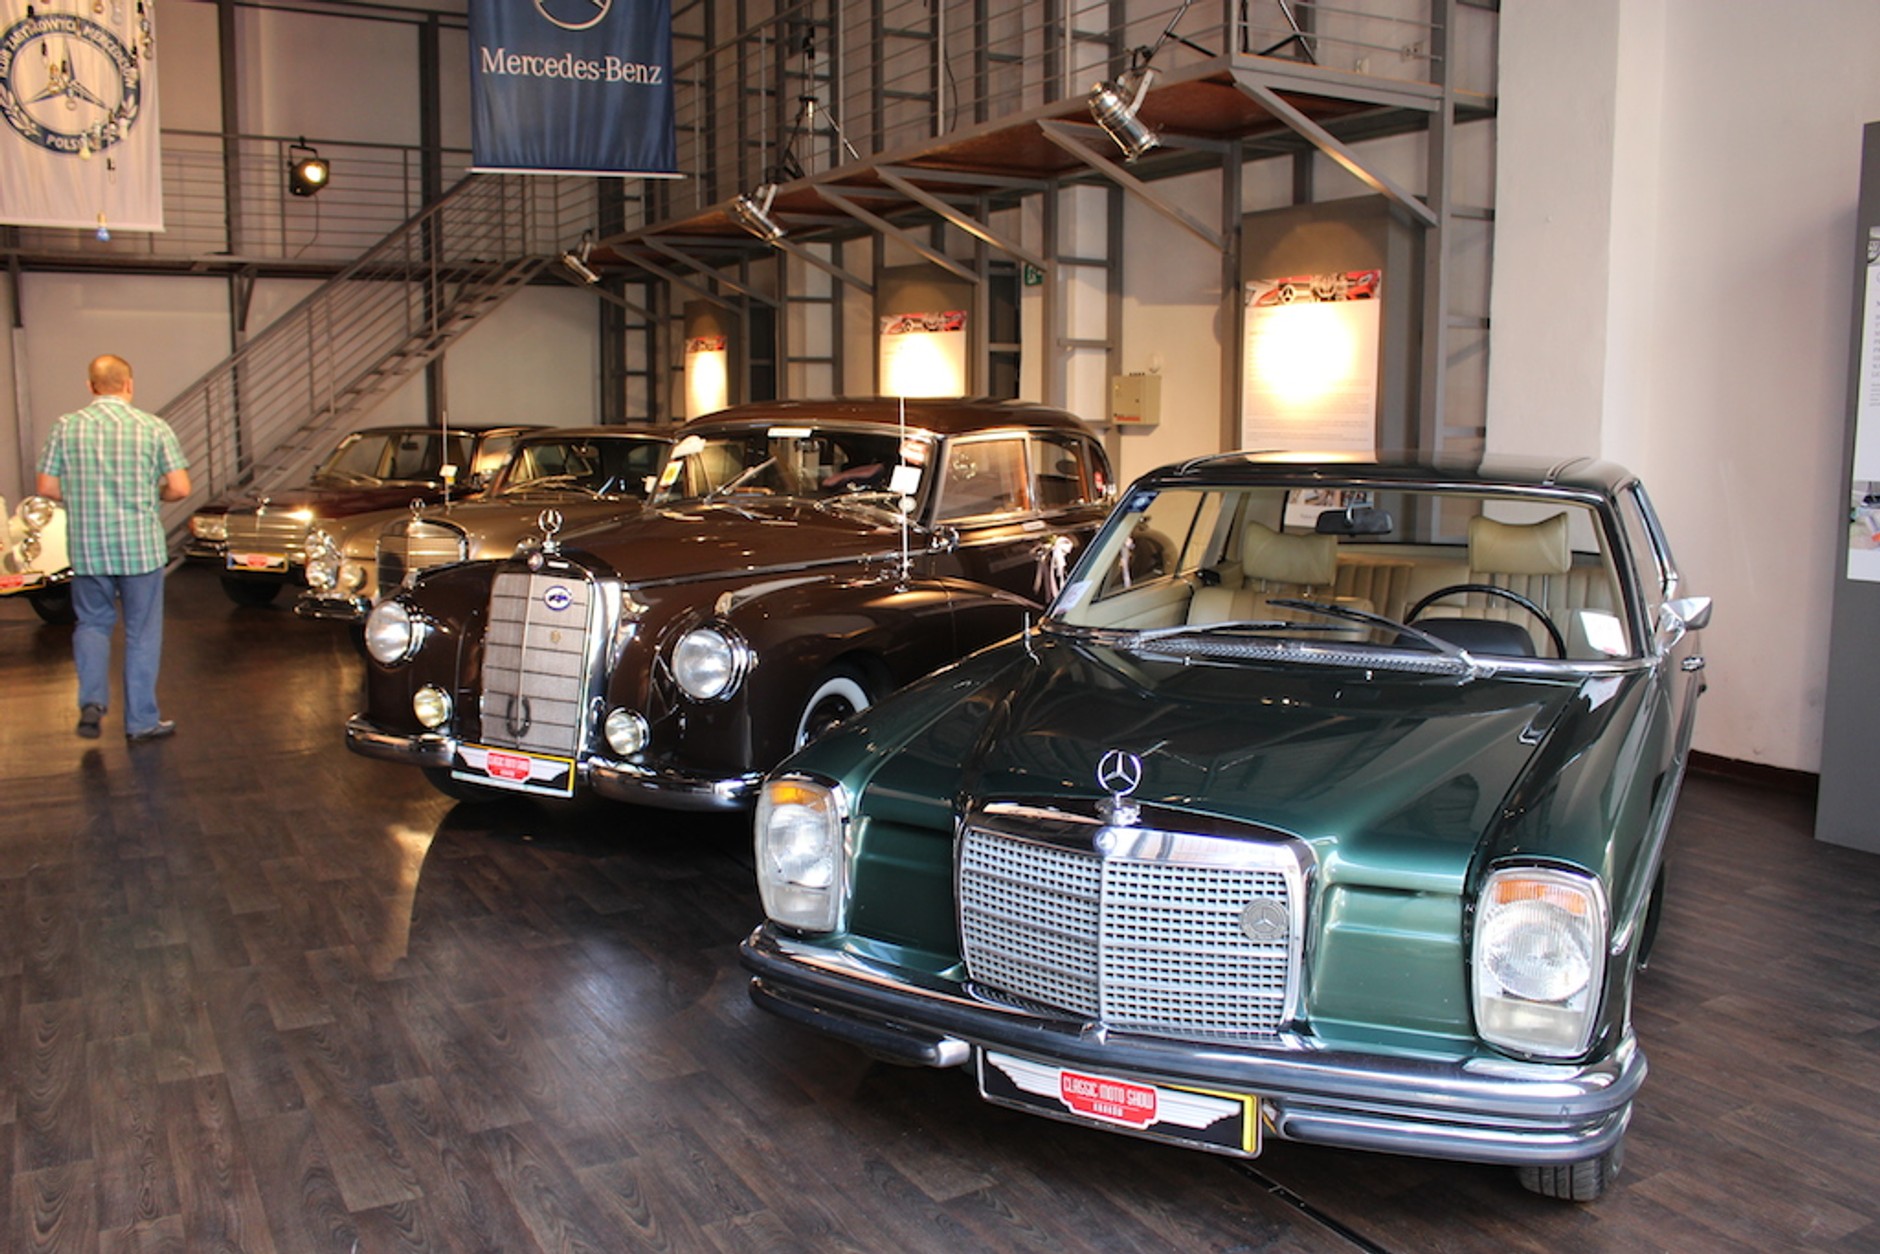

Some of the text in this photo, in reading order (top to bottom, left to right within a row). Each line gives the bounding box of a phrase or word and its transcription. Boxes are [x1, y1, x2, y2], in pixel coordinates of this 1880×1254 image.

[480, 46, 663, 85] Mercedes-Benz
[1063, 1075, 1098, 1098] CLASSIC
[1127, 1088, 1155, 1109] SHOW
